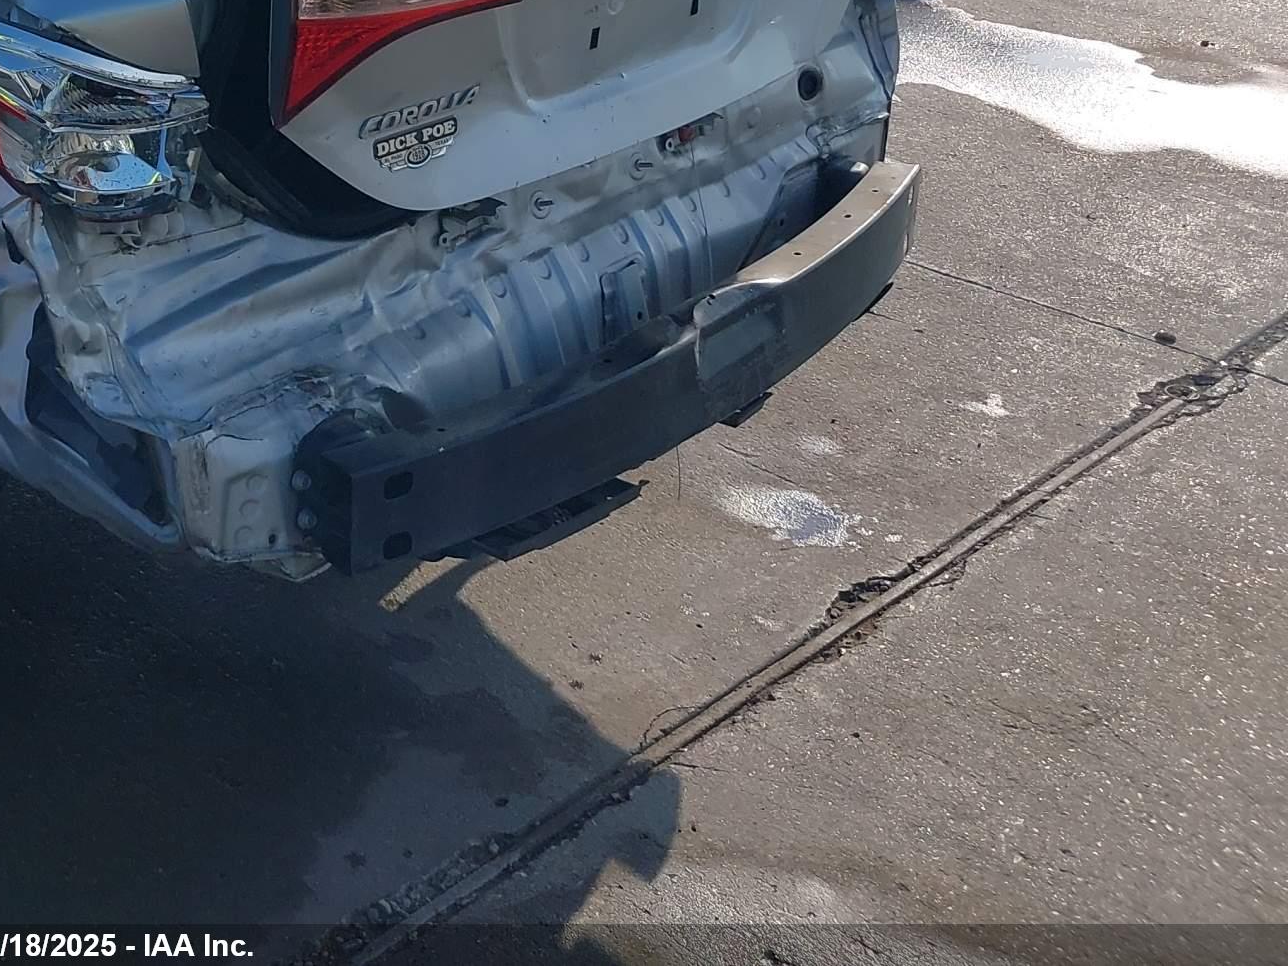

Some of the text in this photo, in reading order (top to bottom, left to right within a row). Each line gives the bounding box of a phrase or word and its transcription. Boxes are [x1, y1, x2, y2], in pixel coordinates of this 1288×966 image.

[358, 82, 481, 140] COROLLA
[376, 119, 456, 157] DICK POE
